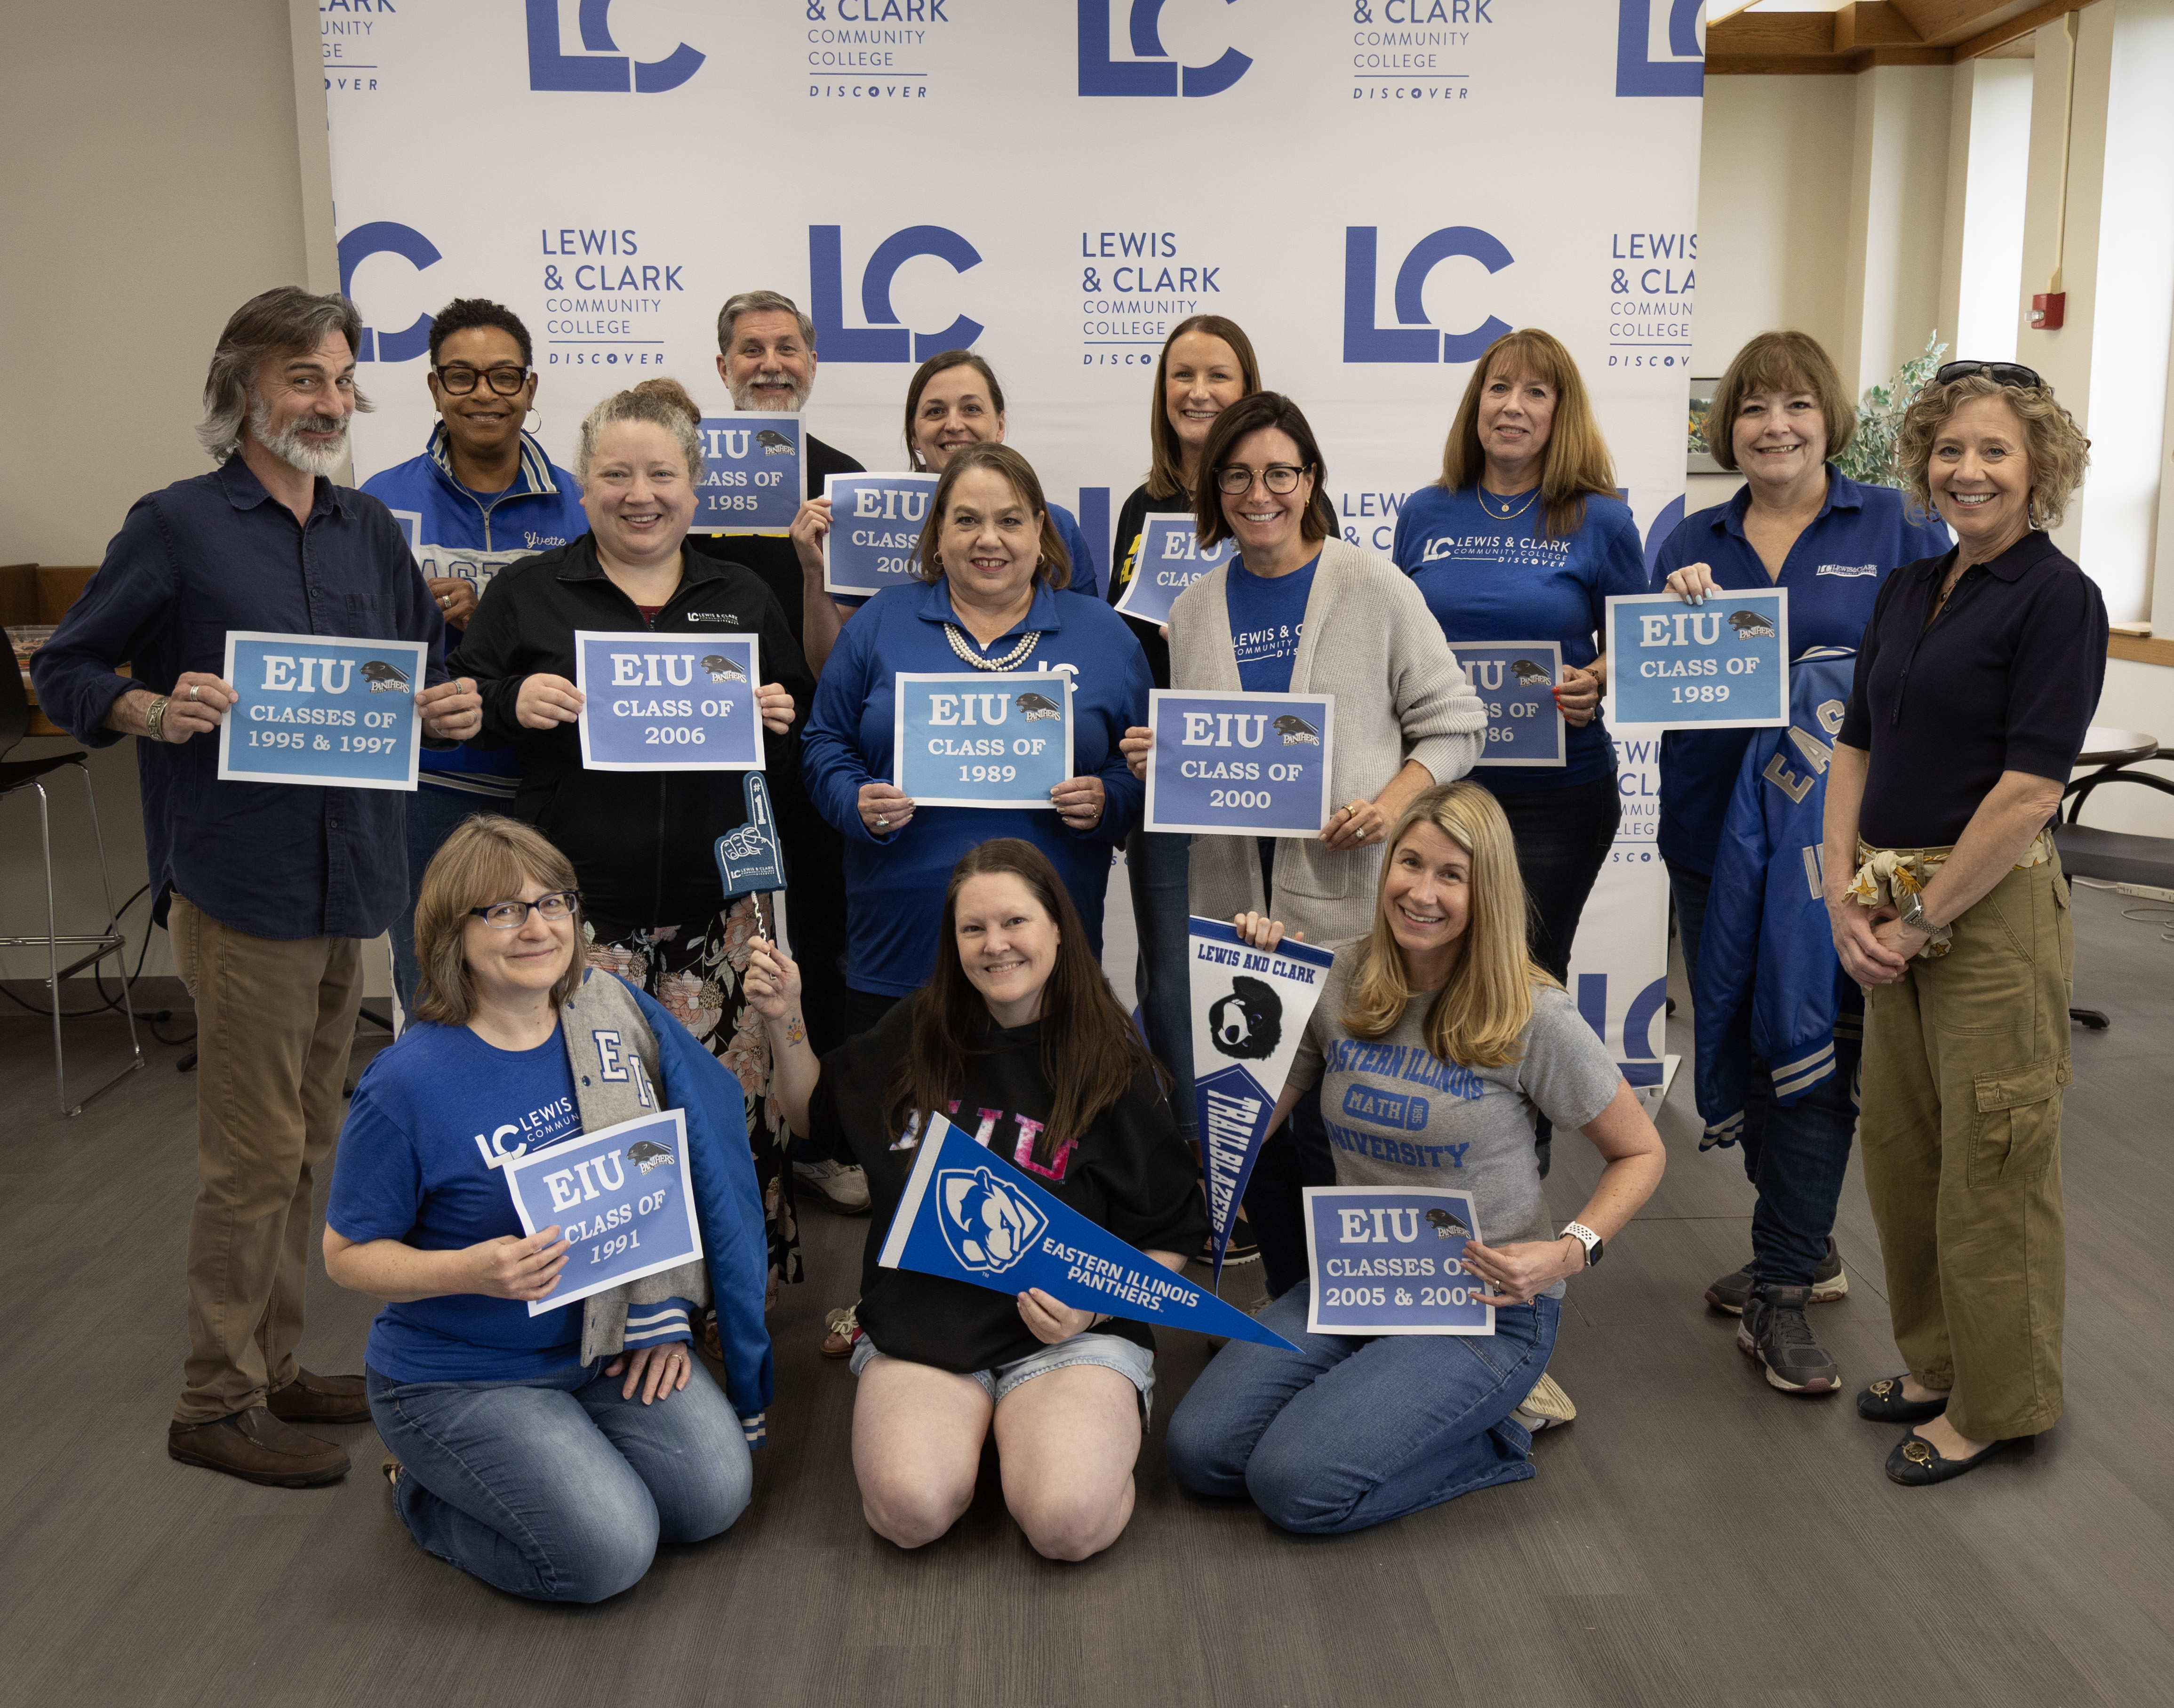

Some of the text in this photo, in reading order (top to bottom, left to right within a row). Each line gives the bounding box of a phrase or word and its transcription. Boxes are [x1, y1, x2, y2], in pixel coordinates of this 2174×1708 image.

[807, 0, 949, 22] & CLARK
[1354, 0, 1493, 24] & CLARK
[321, 21, 373, 35] UNITY
[808, 30, 925, 44] COMMUNITY
[1354, 32, 1469, 46] COMMUNITY
[808, 52, 893, 65] COLLEGE
[1354, 54, 1436, 67] COLLEGE
[809, 86, 927, 97] DISCOVER
[1353, 88, 1468, 99] DISCOVER
[542, 229, 638, 255] LEWIS
[1083, 232, 1176, 257] LEWIS
[544, 265, 684, 291] & CLARK
[1082, 267, 1220, 292] & CLARK
[1611, 269, 1629, 294] &
[547, 299, 661, 312] COMMUNITY
[1083, 301, 1197, 313] COMMUNITY
[547, 320, 631, 334] COLLEGE
[1083, 321, 1166, 335] COLLEGE
[1610, 323, 1689, 336] COLLEGE
[549, 353, 663, 364] DISCOVER
[1083, 354, 1160, 365] DISCO
[765, 444, 796, 456] PANTHERS
[754, 471, 783, 487] OF
[708, 495, 758, 511] 1985
[853, 488, 928, 521] EIU
[1343, 493, 1415, 517] LEW
[524, 531, 567, 549] Yvette
[1457, 536, 1571, 553] LEWIS & CLARK
[1498, 557, 1565, 567] DISCOVER
[1520, 550, 1567, 561] COLLEGE
[1157, 572, 1202, 587] CLAS
[1233, 628, 1274, 648] LEWIS
[1280, 625, 1289, 638] &
[1639, 613, 1723, 647] EIU
[1739, 625, 1775, 638] PANTHERS
[1234, 639, 1293, 656] OMMUNITY
[261, 655, 355, 694] EIU
[610, 654, 695, 686] EIU
[711, 670, 747, 683] PANTHERS
[1462, 661, 1506, 690] IU
[1640, 657, 1760, 678] CLASS OF
[371, 678, 410, 694] PANTHERS
[1520, 674, 1551, 686] PANTHERS
[1672, 685, 1730, 703] 1989
[249, 705, 397, 728] CLASSES OF
[613, 700, 734, 717] CLASS OF
[928, 694, 1011, 725] EIU
[1026, 708, 1061, 721] PANTHERS
[1509, 703, 1539, 718] OF
[645, 727, 705, 744] 2006
[1182, 712, 1268, 748] EIU
[1283, 732, 1319, 746] PANTHERS
[1484, 727, 1514, 742] 86
[248, 730, 396, 755] 1995 & 1997
[928, 739, 1046, 756] CLASS OF
[959, 765, 1016, 782] 1989
[1181, 760, 1303, 781] CLASS OF
[1210, 790, 1271, 809] 2000
[1198, 944, 1316, 984] LEWIS AND CLARK
[1402, 1048, 1484, 1101] ILLINOIS
[520, 1097, 572, 1131] LEWIS
[1347, 1091, 1402, 1120] MATH
[1412, 1104, 1423, 1124] 1895
[639, 1153, 675, 1173] PANTHERS
[543, 1149, 625, 1213] EIU
[565, 1189, 666, 1245] CLASS OF
[1337, 1209, 1420, 1243] EIU
[1437, 1226, 1471, 1239] PANTHERS
[590, 1229, 640, 1264] 1991
[1042, 1237, 1199, 1307] EASTERN ILLINOIS
[1326, 1258, 1436, 1277] CLASSES
[1067, 1266, 1162, 1310] PANTHERS
[1326, 1287, 1386, 1306] 2005
[1394, 1287, 1413, 1306] &
